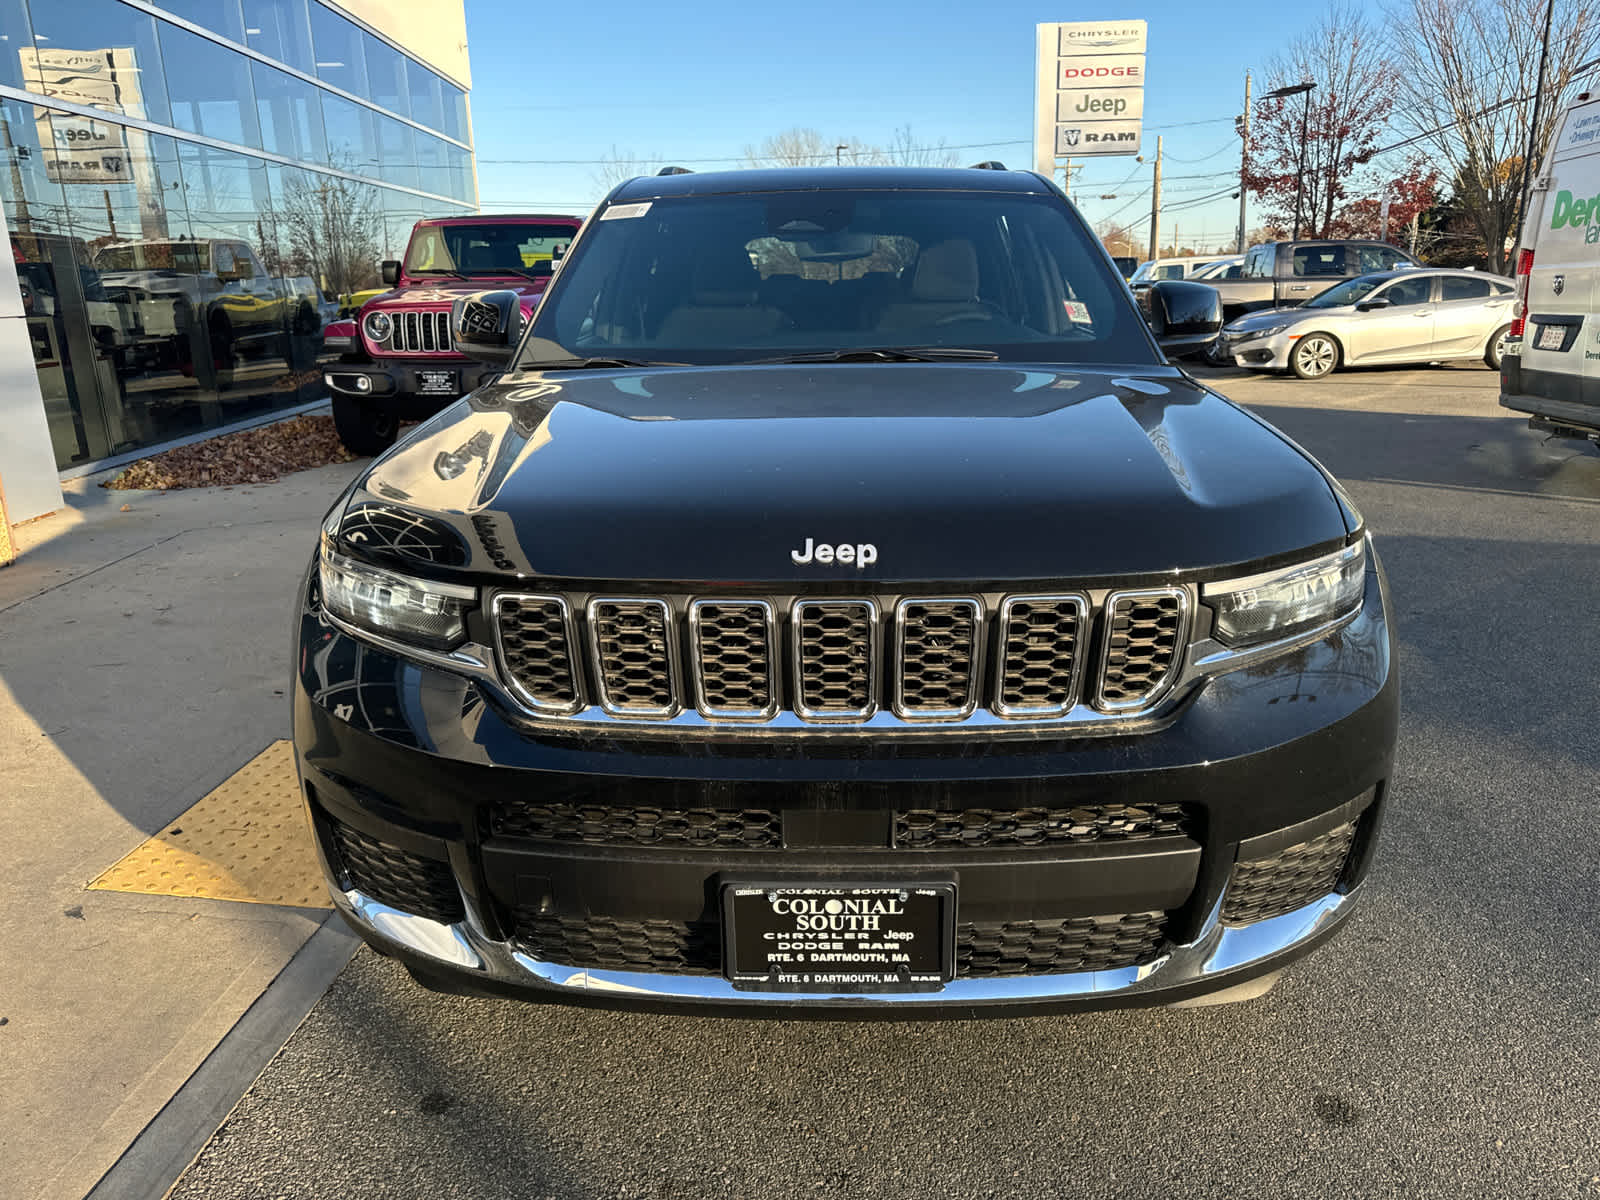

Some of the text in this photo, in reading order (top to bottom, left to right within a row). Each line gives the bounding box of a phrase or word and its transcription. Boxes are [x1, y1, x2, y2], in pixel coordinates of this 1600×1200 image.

[1068, 29, 1139, 38] CHRYSLER
[1065, 66, 1139, 78] DODGE
[1076, 94, 1126, 115] Jeep
[1085, 132, 1136, 142] RAM
[791, 538, 878, 568] Jeep
[915, 888, 936, 896] Jeep
[772, 898, 904, 915] COLONIAL
[796, 914, 880, 931] SOUTH
[763, 929, 914, 941] CHRYSLER Jeep
[778, 942, 900, 950] DODGE RAM
[767, 953, 910, 963] RTE. 6 DARTMOUTH, MA
[778, 974, 801, 983] RTE.
[803, 974, 810, 983] 6
[814, 974, 882, 983] DARTMOUTH,
[883, 974, 900, 983] MA
